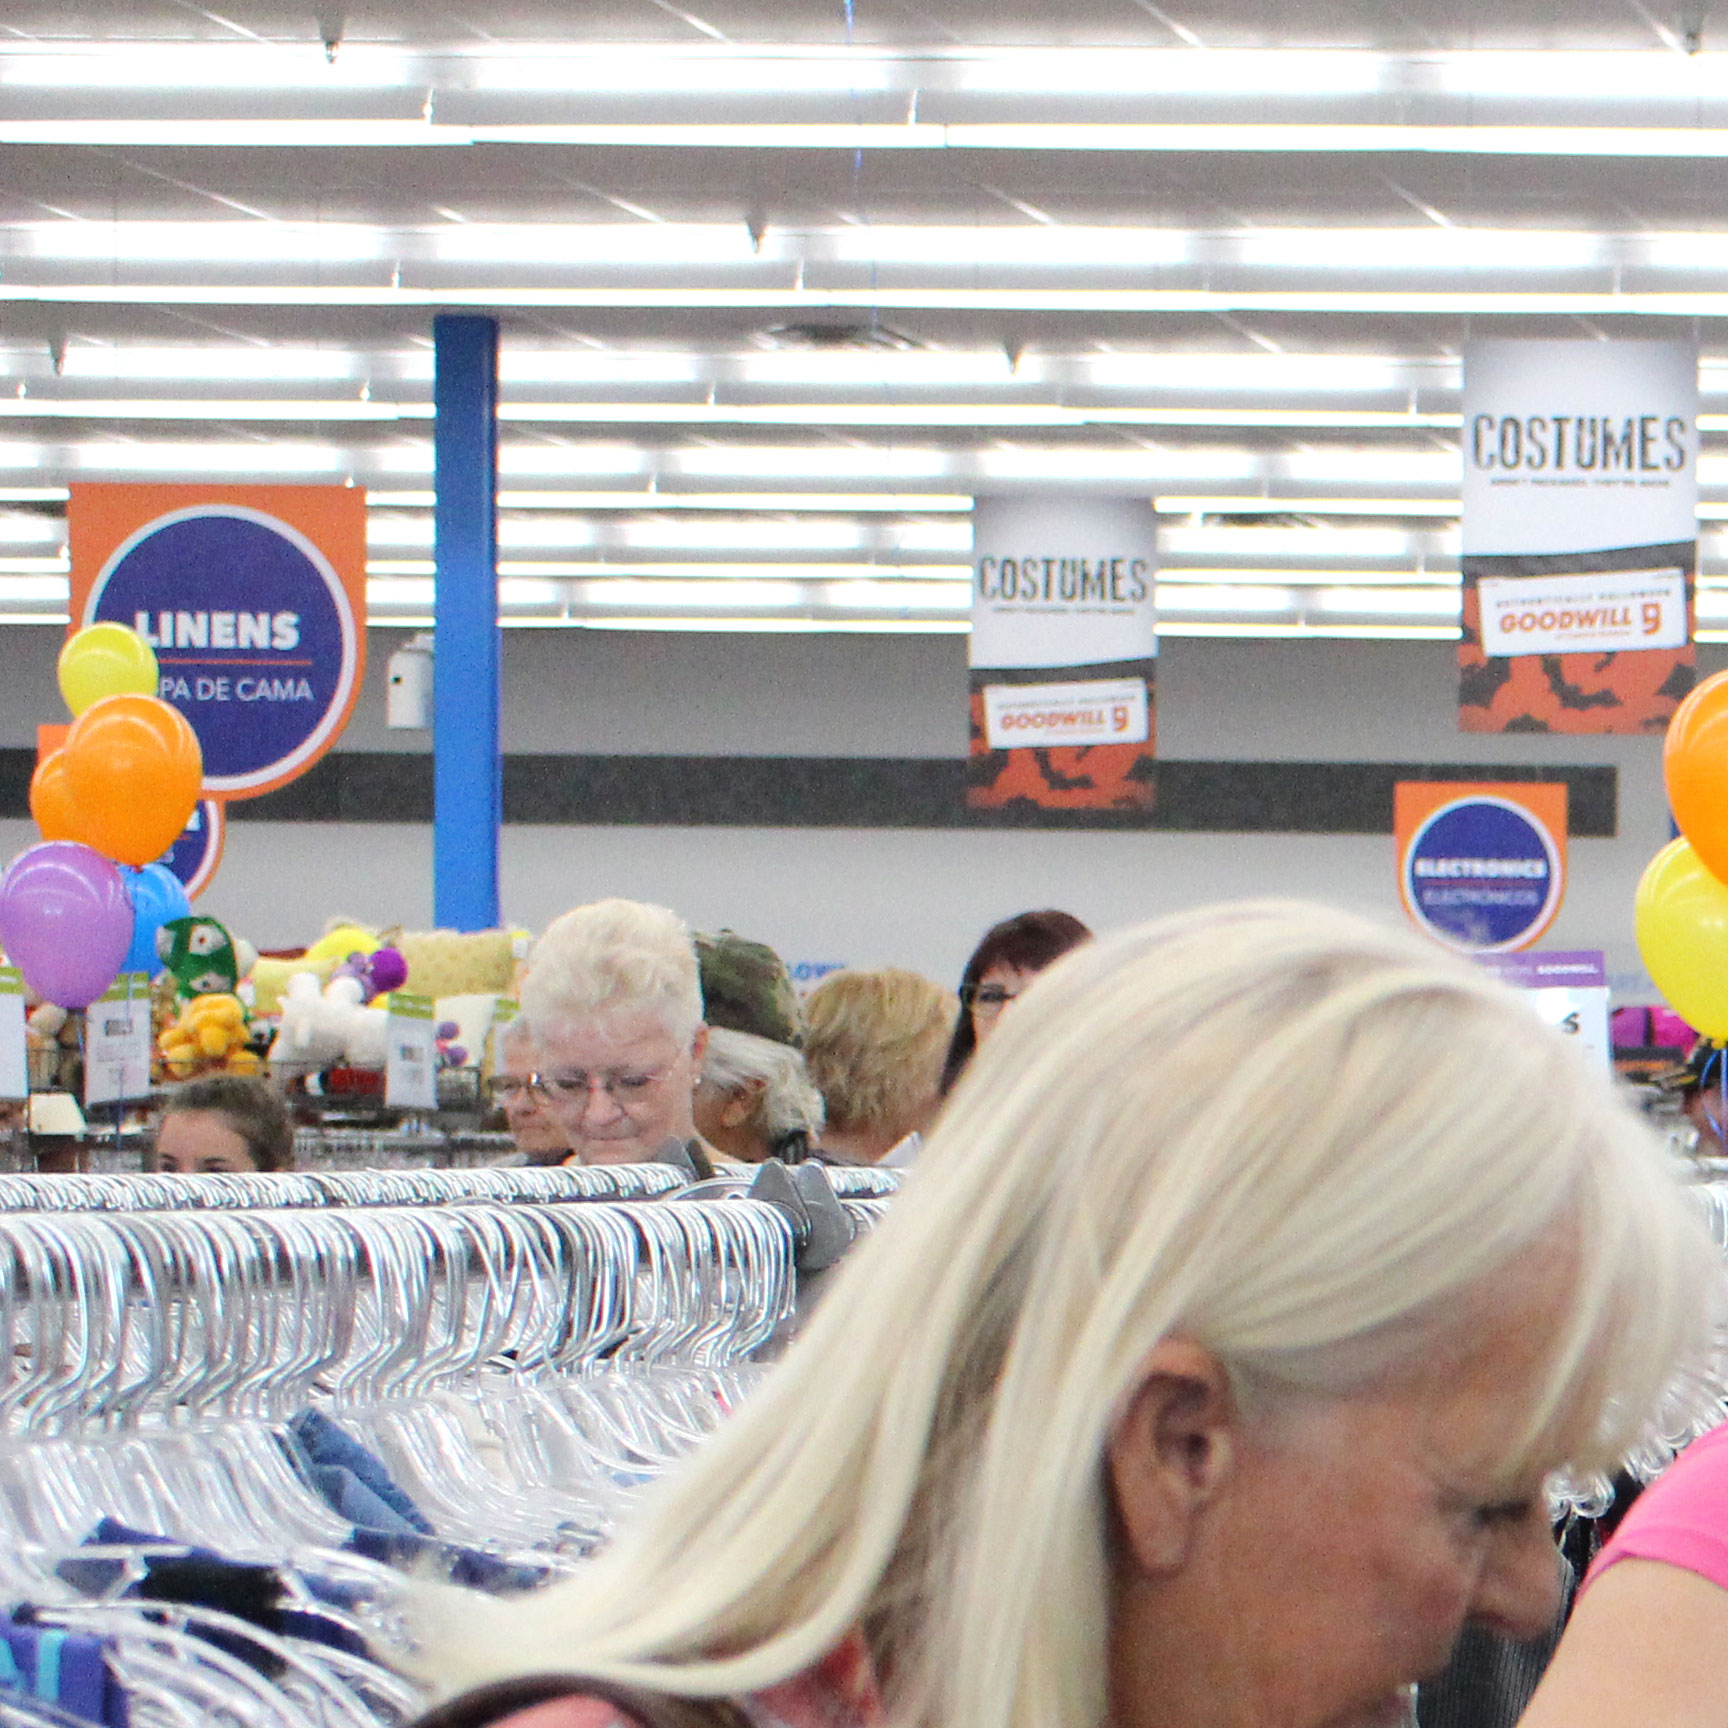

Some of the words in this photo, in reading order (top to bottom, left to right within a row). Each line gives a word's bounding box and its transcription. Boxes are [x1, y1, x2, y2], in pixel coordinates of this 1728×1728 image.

[1473, 415, 1686, 471] COSTUMES
[980, 556, 1147, 602] COSTUMES
[134, 610, 300, 650] LINENS
[1500, 607, 1632, 634] GOODWILL
[158, 676, 191, 700] PA
[196, 677, 231, 701] DE
[236, 676, 315, 700] CAMA
[1001, 710, 1106, 731] GOODWILL
[1414, 858, 1549, 879] ELECTRONICS
